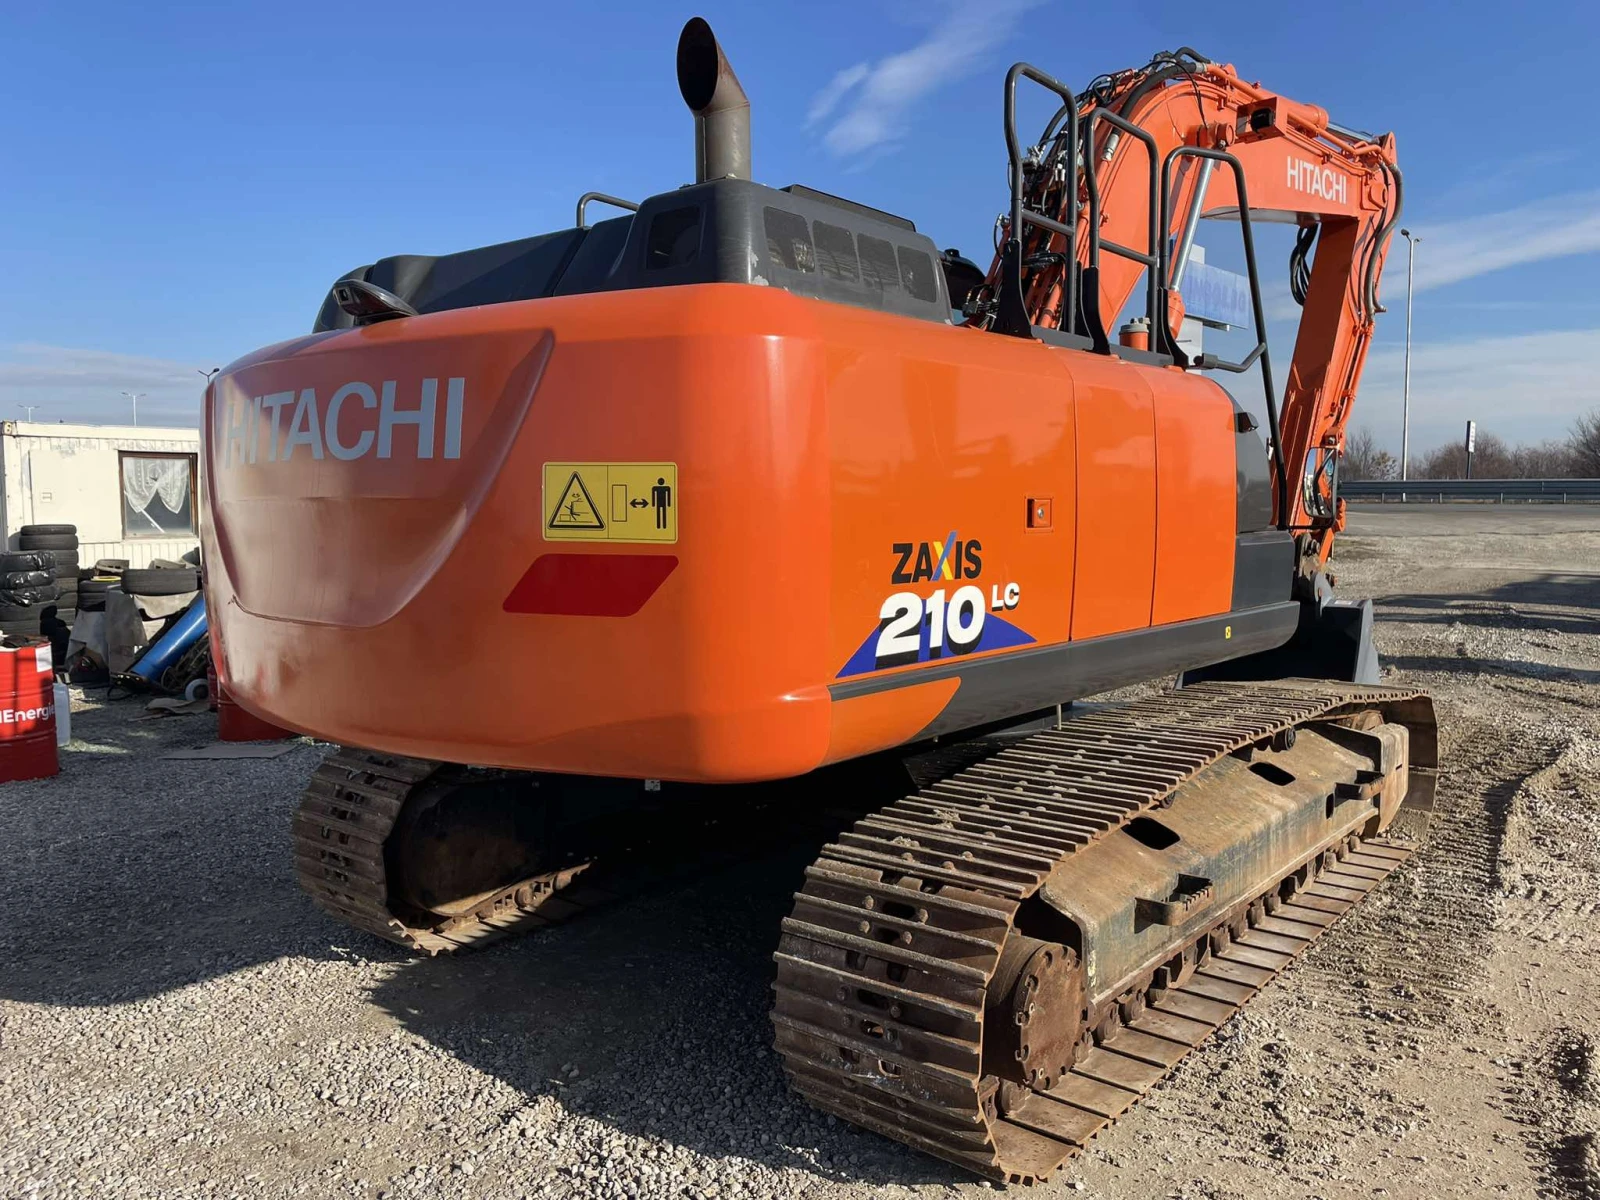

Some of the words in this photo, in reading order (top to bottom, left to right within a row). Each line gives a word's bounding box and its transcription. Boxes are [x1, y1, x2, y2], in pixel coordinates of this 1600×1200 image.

[1287, 155, 1347, 205] HITACHI
[225, 377, 466, 469] HITACHI
[891, 530, 982, 584] ZAXIS
[875, 585, 986, 667] 210
[991, 582, 1020, 611] LC
